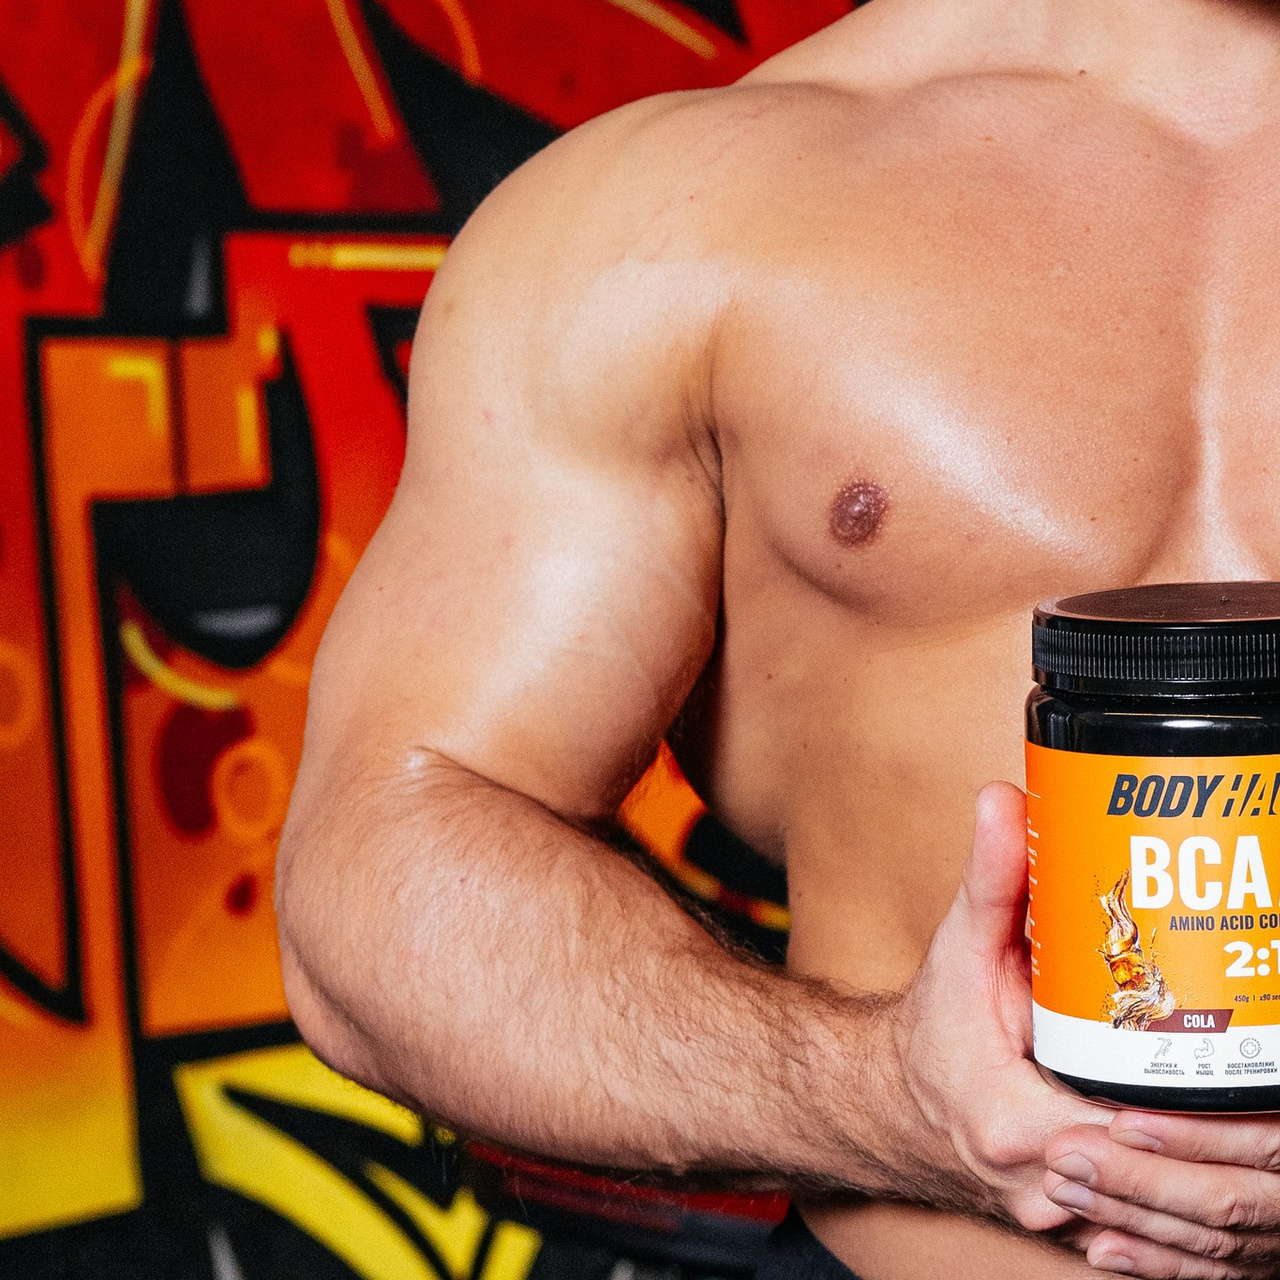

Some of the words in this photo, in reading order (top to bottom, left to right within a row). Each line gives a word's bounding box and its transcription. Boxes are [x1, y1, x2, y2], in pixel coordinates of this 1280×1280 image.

[1169, 915, 1215, 931] AMINO
[1220, 914, 1255, 931] ACID
[1234, 994, 1250, 1003] 450g
[1183, 1014, 1216, 1029] COLA
[1150, 1061, 1173, 1069] ЭНЕРГИЯ
[1227, 1060, 1275, 1069] ВОССТАНОВЛЕНИЕ
[1144, 1068, 1185, 1076] ВЫНОСЛИВОСТЬ
[1244, 1067, 1278, 1075] ТРЕНИРОВКИ
